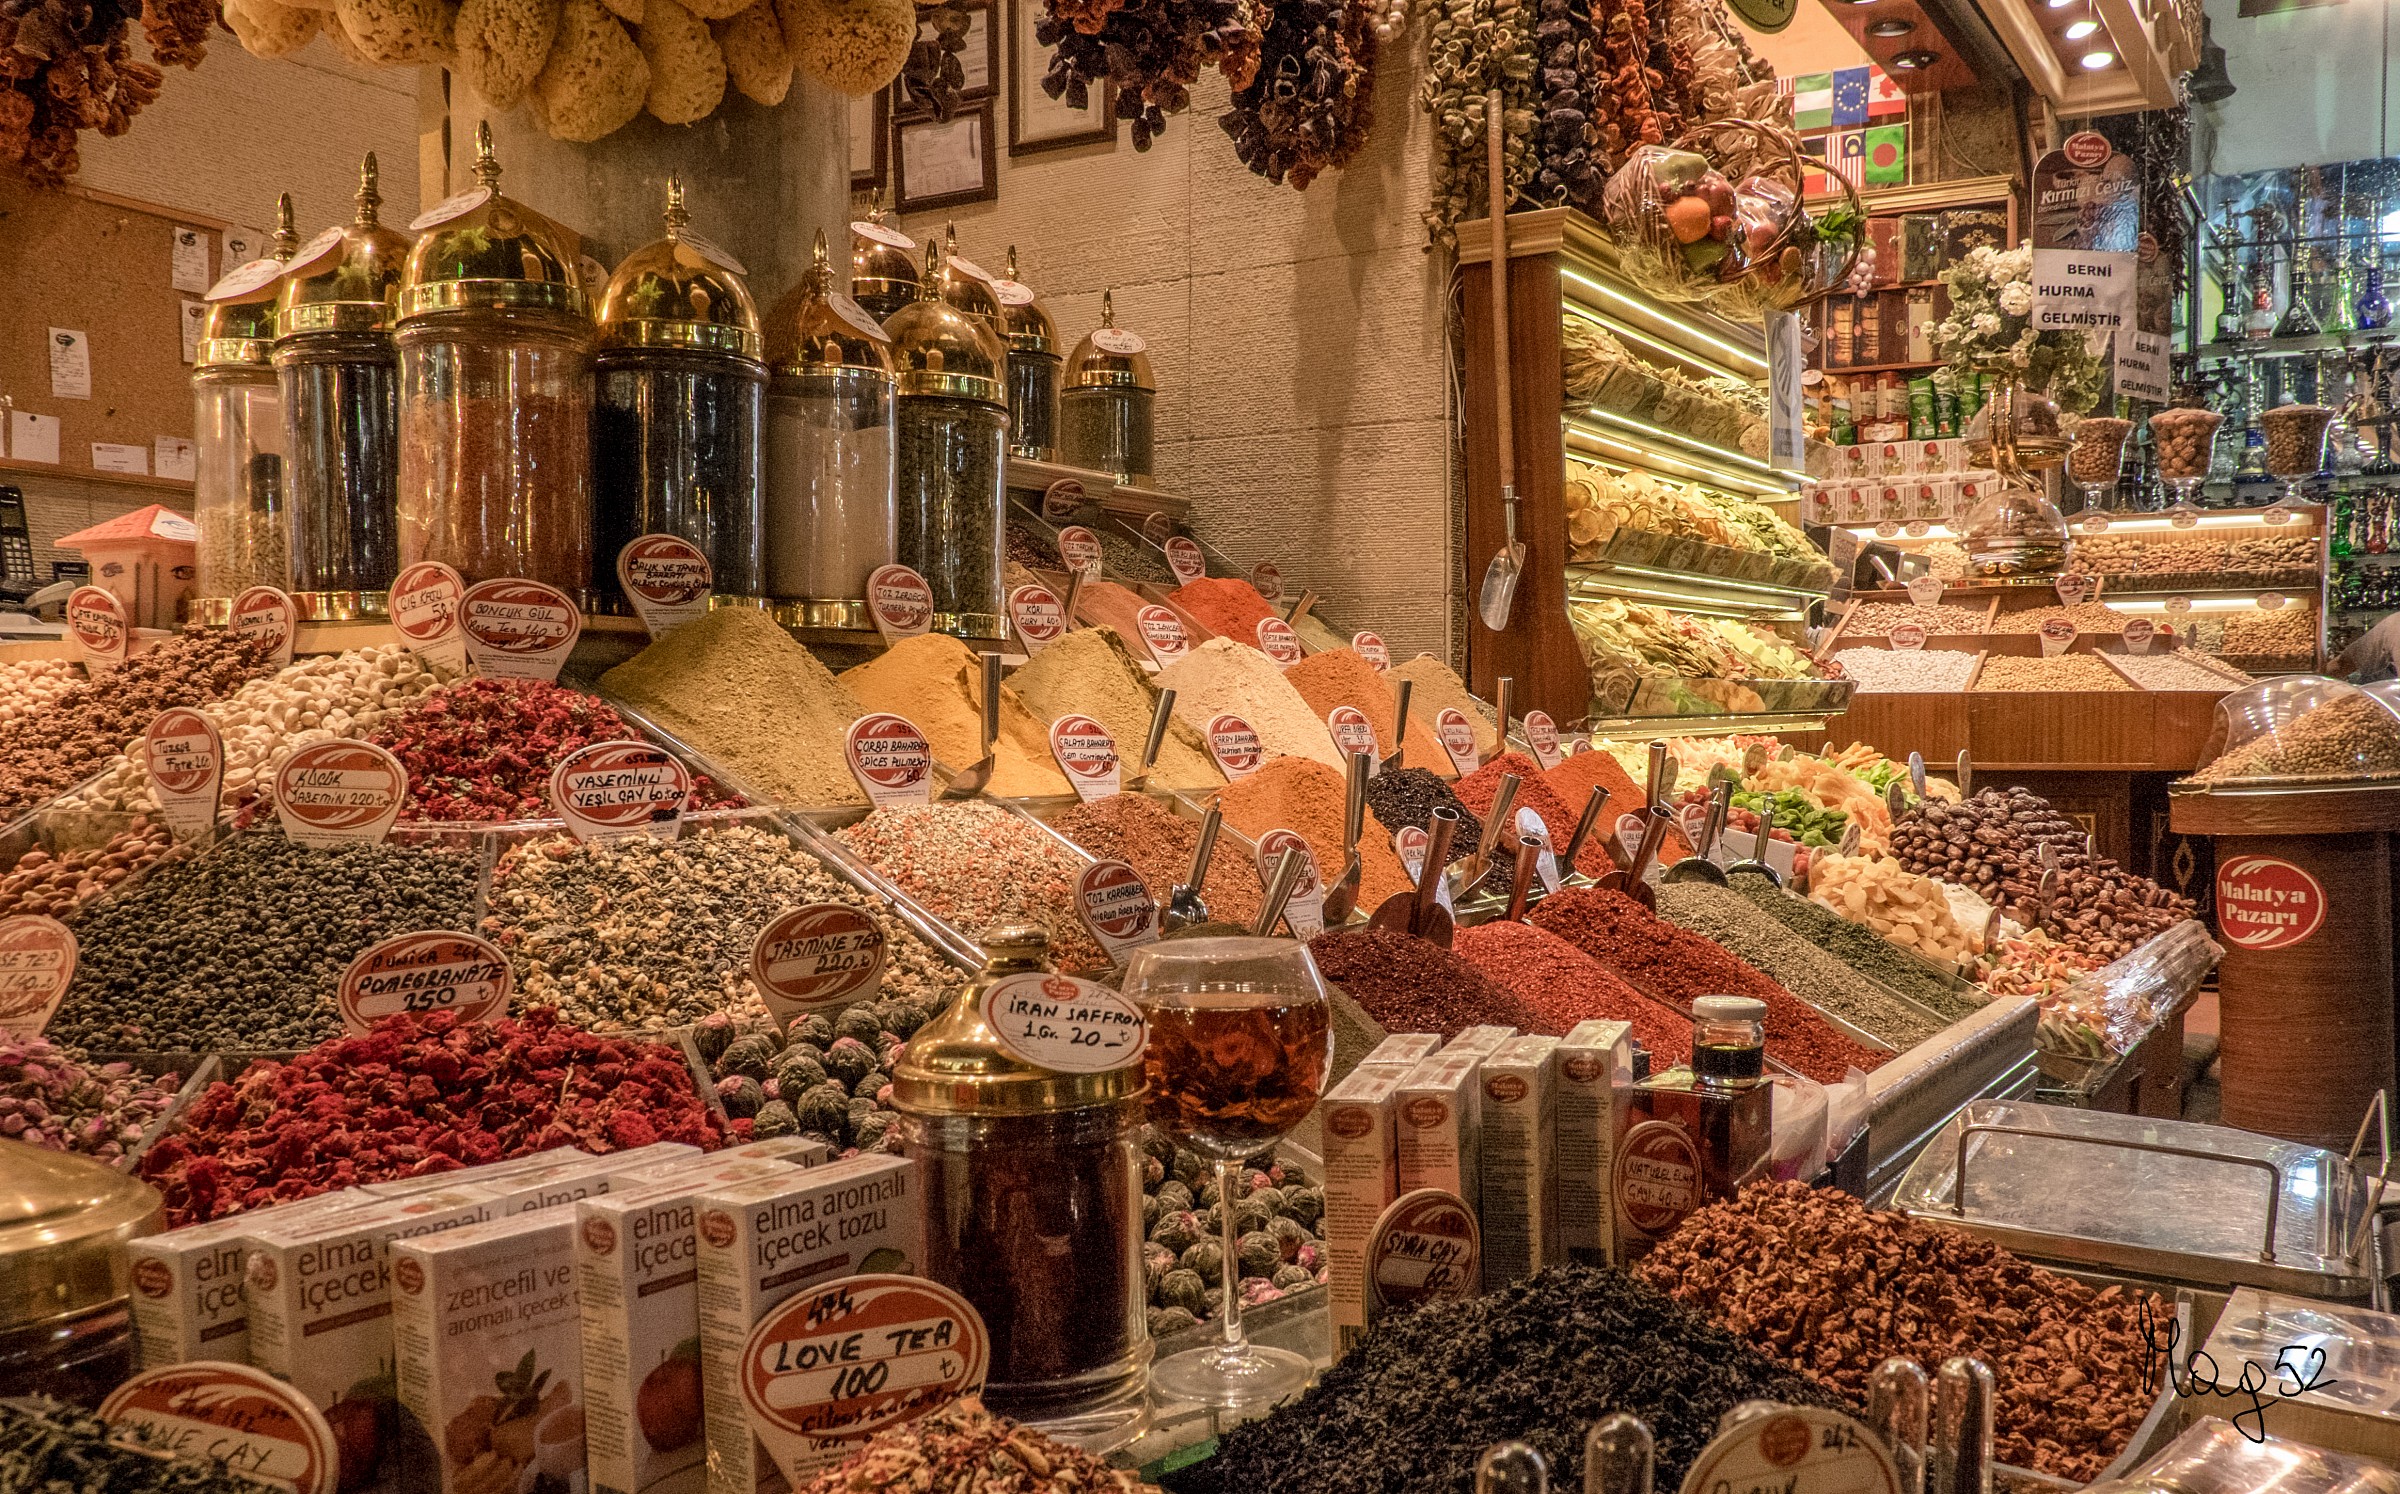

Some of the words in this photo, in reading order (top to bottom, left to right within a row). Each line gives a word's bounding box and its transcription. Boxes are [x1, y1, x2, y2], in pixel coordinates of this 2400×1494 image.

[2067, 264, 2112, 277] BERNİ
[2039, 285, 2095, 298] HURMA
[2041, 312, 2121, 328] GELMİŞTİR
[2135, 342, 2160, 356] BERNİ
[2119, 357, 2150, 372] HURMA
[2120, 379, 2163, 397] GELMİŞTİR
[877, 587, 892, 598] TOZ
[475, 603, 522, 618] BONCUK
[528, 607, 555, 620] GÜL
[1058, 737, 1086, 748] SALATA
[574, 790, 615, 808] YEŞİL
[618, 787, 645, 805] ÇAY
[1086, 891, 1105, 904] TOZ
[2221, 880, 2306, 907] Malatya
[2225, 903, 2298, 926] Pazarı
[853, 931, 884, 951] TEA
[356, 961, 508, 995] POMEGRANATE
[403, 987, 457, 1012] 250
[1066, 1007, 1146, 1027] SAFFRON
[755, 1197, 815, 1235] elma
[822, 1171, 907, 1218] aromalı
[633, 1204, 695, 1241] elma
[757, 1220, 830, 1269] içecek
[837, 1208, 888, 1242] tozu
[298, 1238, 373, 1276] elma
[299, 1260, 392, 1314] içecek
[448, 1267, 537, 1313] zencefil
[544, 1263, 572, 1286] ve
[448, 1302, 513, 1336] aromalı
[518, 1291, 570, 1320] içecek
[774, 1332, 864, 1373] LOVE
[886, 1319, 954, 1356] TEA
[830, 1360, 889, 1401] 100
